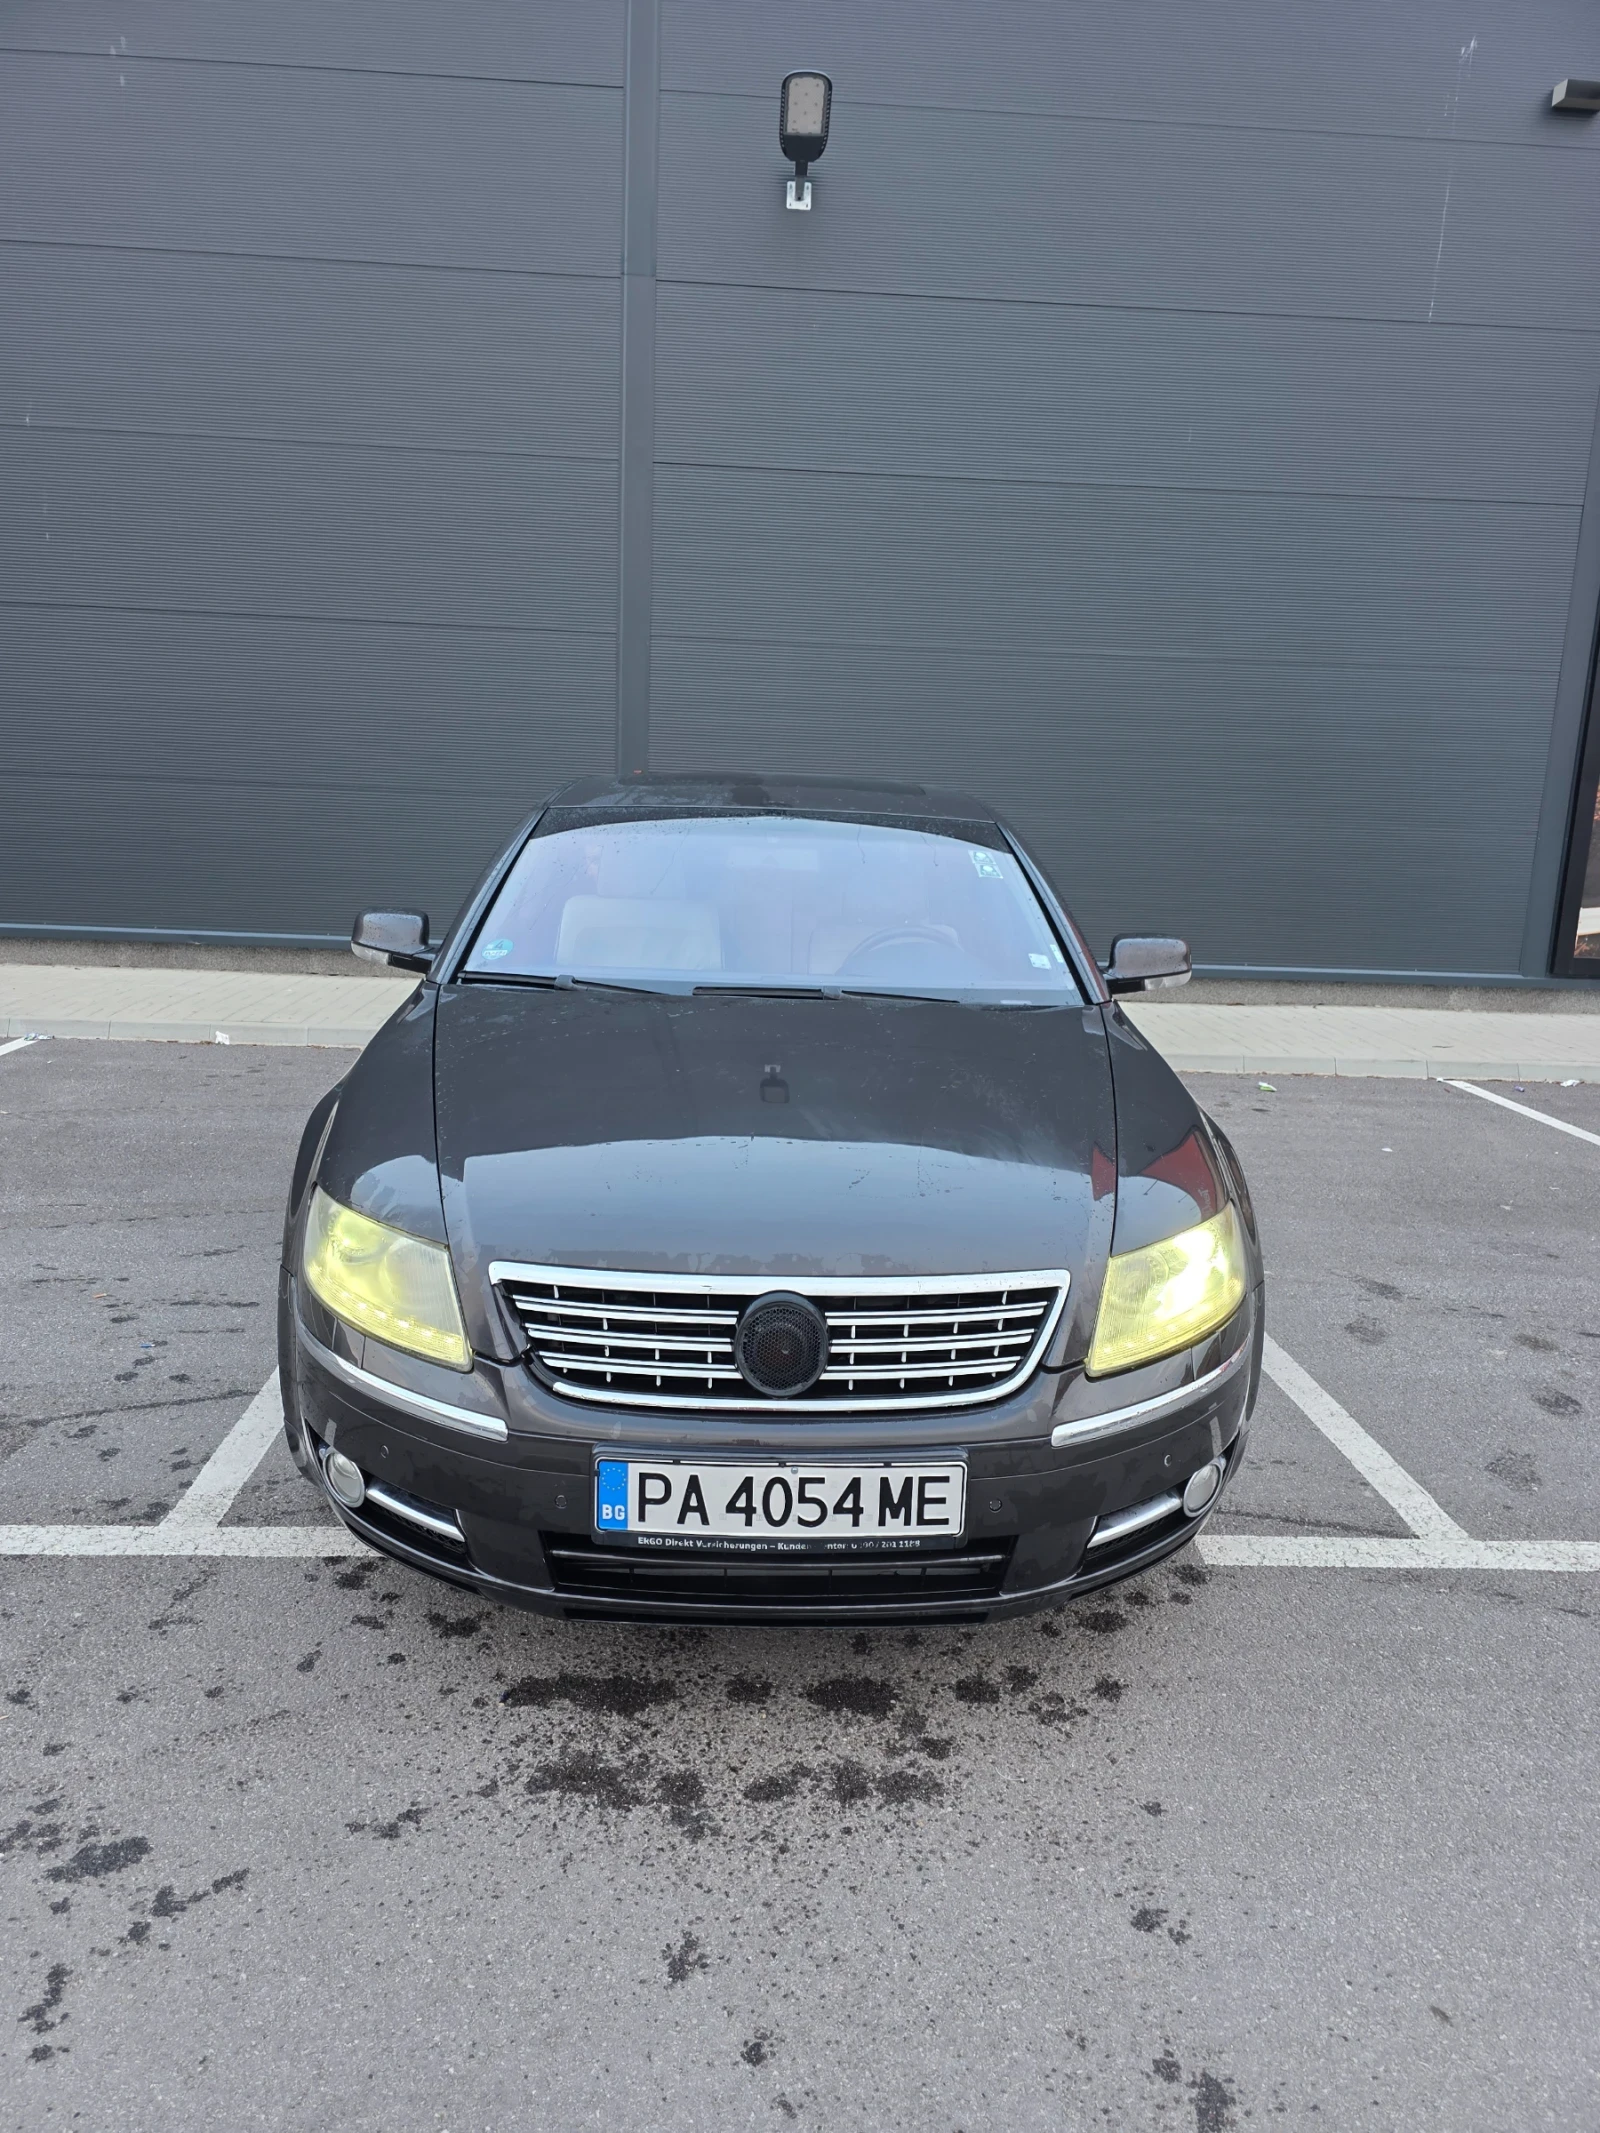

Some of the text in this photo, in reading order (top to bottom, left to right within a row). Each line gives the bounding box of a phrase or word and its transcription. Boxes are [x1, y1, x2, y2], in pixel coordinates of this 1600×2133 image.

[602, 1504, 626, 1521] BG
[637, 1472, 950, 1528] PA 4054 ME
